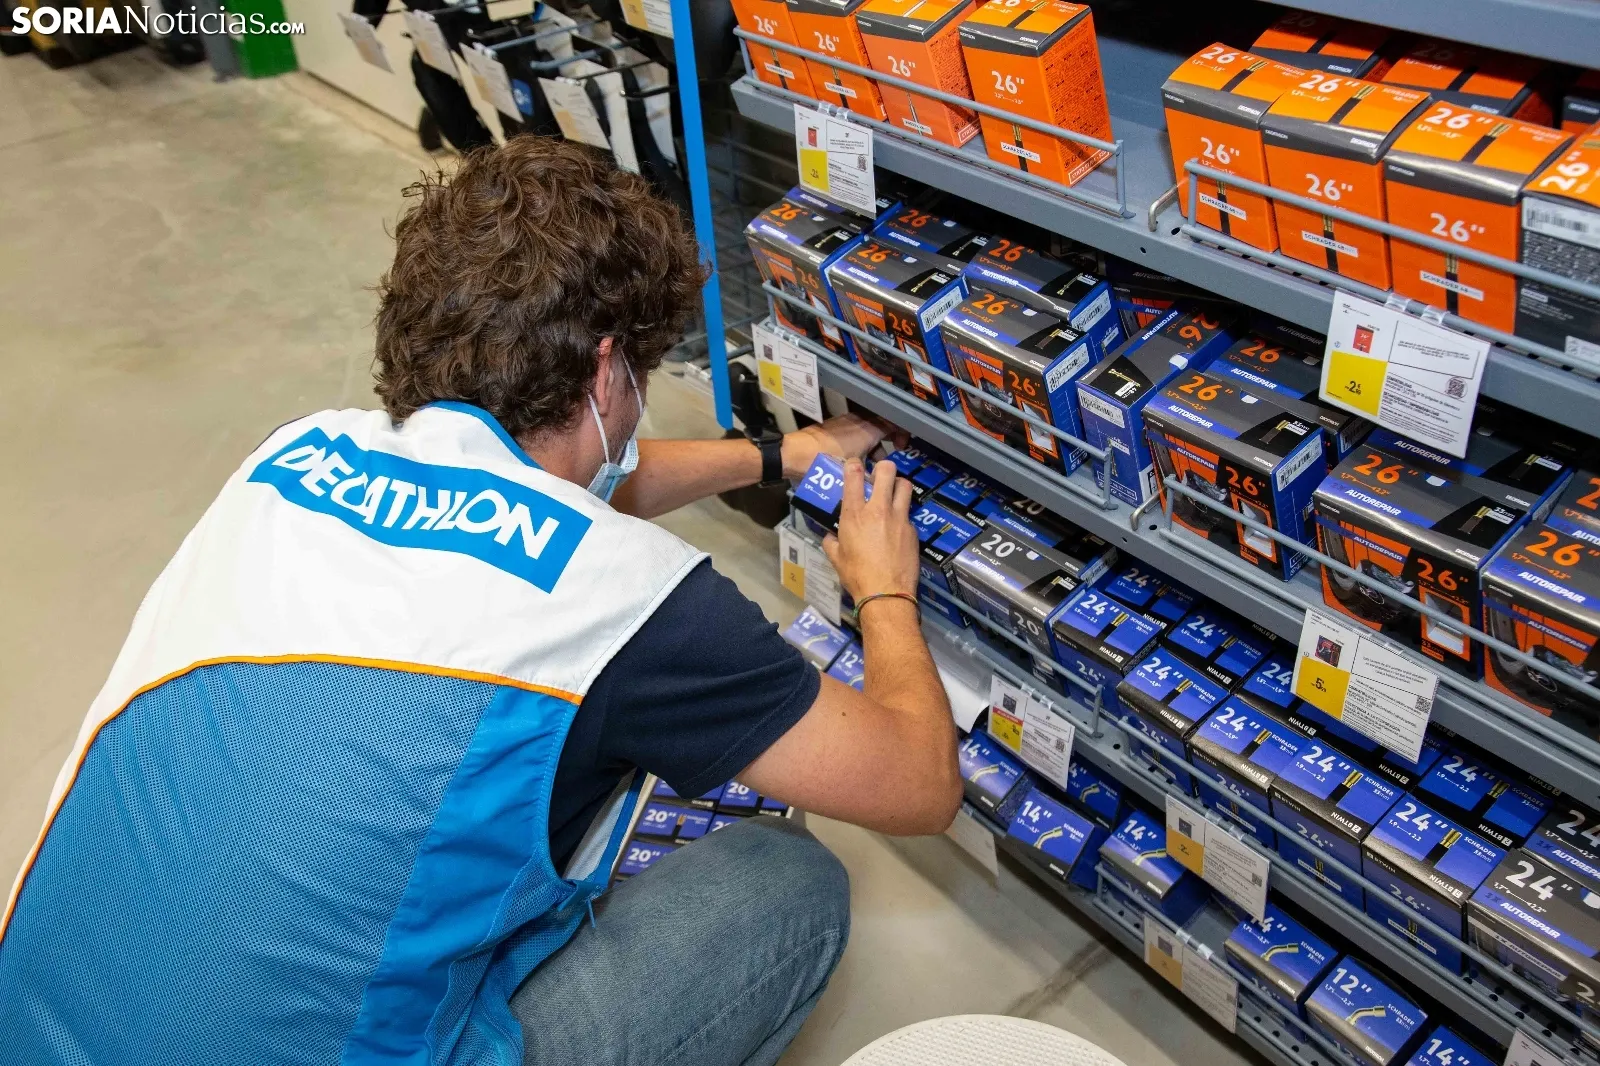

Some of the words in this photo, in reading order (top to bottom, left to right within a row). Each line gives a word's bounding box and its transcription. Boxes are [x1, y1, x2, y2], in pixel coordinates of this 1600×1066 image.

[814, 31, 839, 52] 26"
[888, 55, 916, 77] 26"
[1200, 46, 1255, 64] 26"
[991, 70, 1025, 95] 26"
[1298, 74, 1360, 93] 26"
[1424, 107, 1494, 129] 26"
[1200, 137, 1240, 165] 26"
[1305, 173, 1353, 201] 26"
[1430, 212, 1485, 242] 26"
[988, 239, 1035, 262] 26"
[1304, 233, 1336, 249] SCHRADER
[1422, 273, 1460, 290] SCHRADER
[971, 293, 1019, 315] 26"
[888, 312, 916, 336] 26"
[961, 318, 999, 338] AUTOREPAIR
[1141, 310, 1179, 341] AUTOREPAIR
[1007, 370, 1041, 397] 26"
[1178, 375, 1234, 401] 26"
[1231, 367, 1277, 390] AUTOREPAIR
[1167, 404, 1213, 429] AUTOREPAIR
[1176, 447, 1216, 471] AUTOREPAIR
[1393, 440, 1450, 465] AUTOREPAIR
[808, 465, 844, 490] 20"
[1354, 454, 1418, 484] 26"
[1225, 466, 1266, 496] 26"
[271, 444, 560, 560] DECATHLON
[1344, 489, 1402, 516] AUTOREPAIR
[914, 508, 945, 525] 20"
[981, 533, 1023, 558] 20"
[1353, 536, 1403, 562] AUTOREPAIR
[1123, 568, 1161, 589] 24"
[1416, 558, 1469, 591] 26"
[1517, 570, 1586, 604] AUTOREPAIR
[1079, 593, 1120, 616] 24"
[1129, 616, 1153, 632] SCHRADER
[1186, 615, 1228, 638] 24"
[1528, 619, 1588, 650] AUTOREPAIR
[1142, 656, 1184, 681] 24"
[1206, 665, 1228, 683] BTWIN
[1192, 683, 1216, 702] SCHRADER
[1159, 709, 1179, 726] BTWIN
[1215, 706, 1261, 732] 24"
[1288, 716, 1311, 734] BTWIN
[961, 739, 990, 758] 14"
[1271, 734, 1298, 752] SCHRADER
[1302, 745, 1350, 773] 24"
[1442, 754, 1496, 783] 24"
[1241, 763, 1262, 779] BTWIN
[1378, 763, 1403, 781] BTWIN
[1364, 776, 1394, 796] SCHRADER
[1512, 787, 1544, 807] SCHRADER
[645, 809, 676, 823] 20"
[1023, 801, 1052, 824] 14"
[1331, 812, 1354, 831] BTWIN
[1395, 801, 1448, 832] 24"
[1124, 819, 1157, 841] 14"
[1478, 823, 1505, 843] BTWIN
[1464, 836, 1496, 858] SCHRADER
[1429, 874, 1455, 895] BTWIN
[1506, 860, 1573, 901] 24"
[1500, 901, 1561, 939] AUTOREPAIR
[1300, 941, 1325, 961] SCHRADER
[1335, 967, 1373, 994] 12"
[1387, 1003, 1415, 1025] SCHRADER
[1426, 1038, 1471, 1066] 14"
